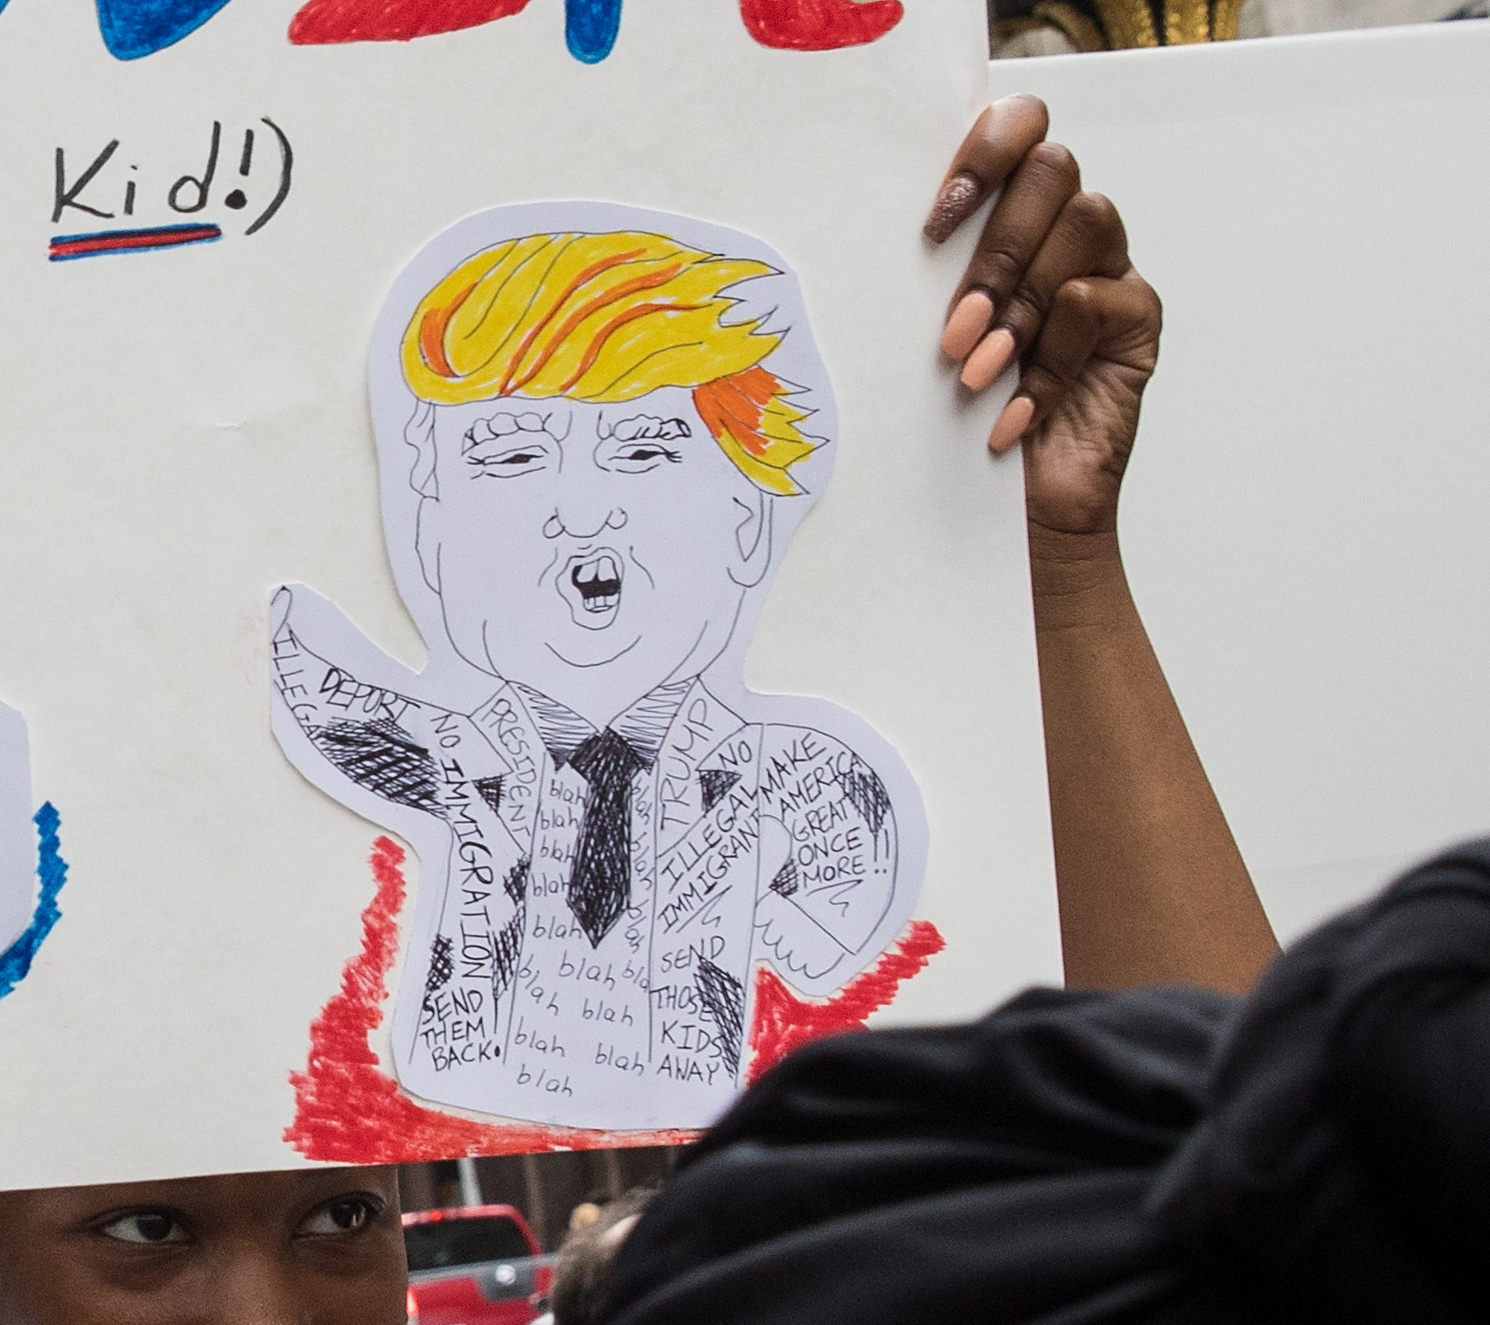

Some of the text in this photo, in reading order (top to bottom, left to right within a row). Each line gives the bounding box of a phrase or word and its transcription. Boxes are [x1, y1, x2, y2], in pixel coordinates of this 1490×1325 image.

[51, 118, 294, 237] Kid!)
[319, 667, 422, 725] DEPORT
[481, 698, 537, 837] PRESIDENT
[660, 698, 714, 831] TRUMP
[718, 739, 753, 770] NO
[760, 732, 828, 805] MAKE
[779, 751, 863, 823] AMERICA
[662, 786, 759, 892] ILLEGAL
[792, 794, 852, 843] GREAT
[430, 713, 495, 979] NO IMMIGRATION
[798, 827, 864, 867] ONCE
[532, 914, 583, 940] blah
[559, 950, 616, 992] blah
[661, 935, 726, 973] SEND
[421, 987, 484, 1025] SEND
[581, 998, 634, 1027] blah
[649, 984, 714, 1023] THOSE
[420, 1016, 486, 1049] THEM
[514, 1015, 566, 1058] blah
[661, 1020, 723, 1058] KIDS
[595, 1042, 645, 1077] blah
[516, 1063, 574, 1098] blah
